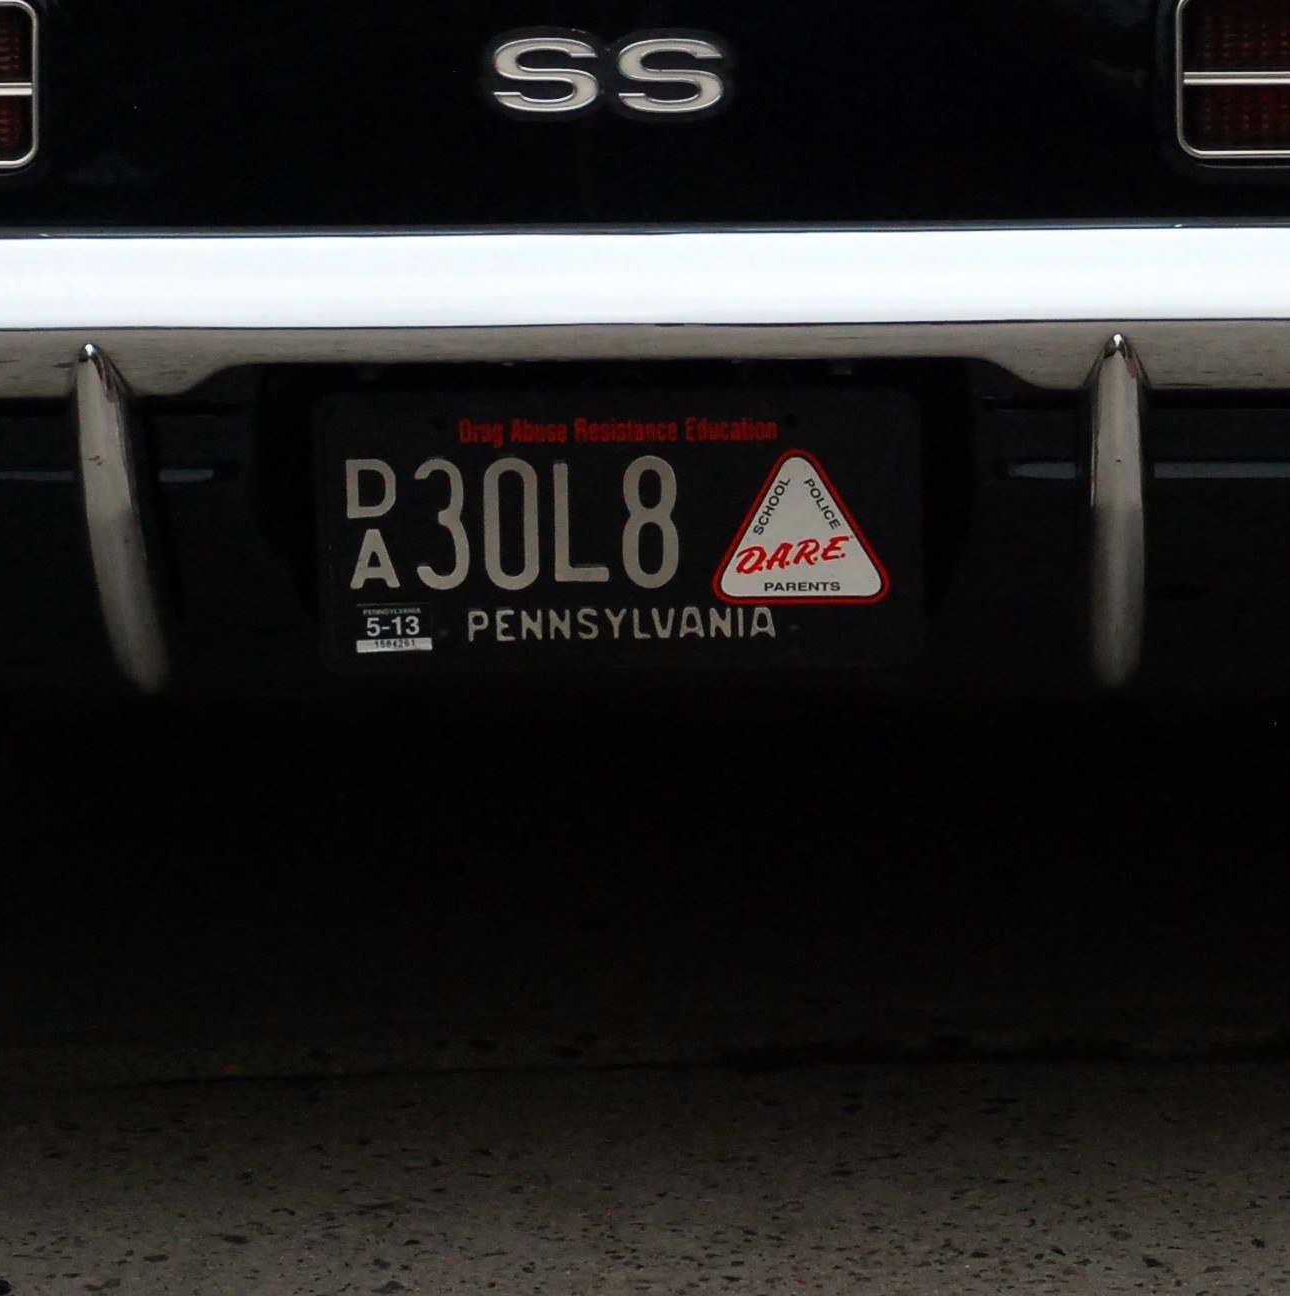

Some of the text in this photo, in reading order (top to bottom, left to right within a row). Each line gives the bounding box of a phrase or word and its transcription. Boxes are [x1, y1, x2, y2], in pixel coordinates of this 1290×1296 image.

[492, 37, 723, 115] SS
[459, 417, 779, 448] Drug Abuse Resistance Education
[753, 477, 791, 535] SCHOOL
[803, 478, 841, 530] POLICE
[763, 581, 841, 592] PARENTS
[361, 607, 422, 615] PENNSYLVANIA
[365, 615, 421, 638] 5-13
[467, 605, 776, 643] PENNSYLVANIA
